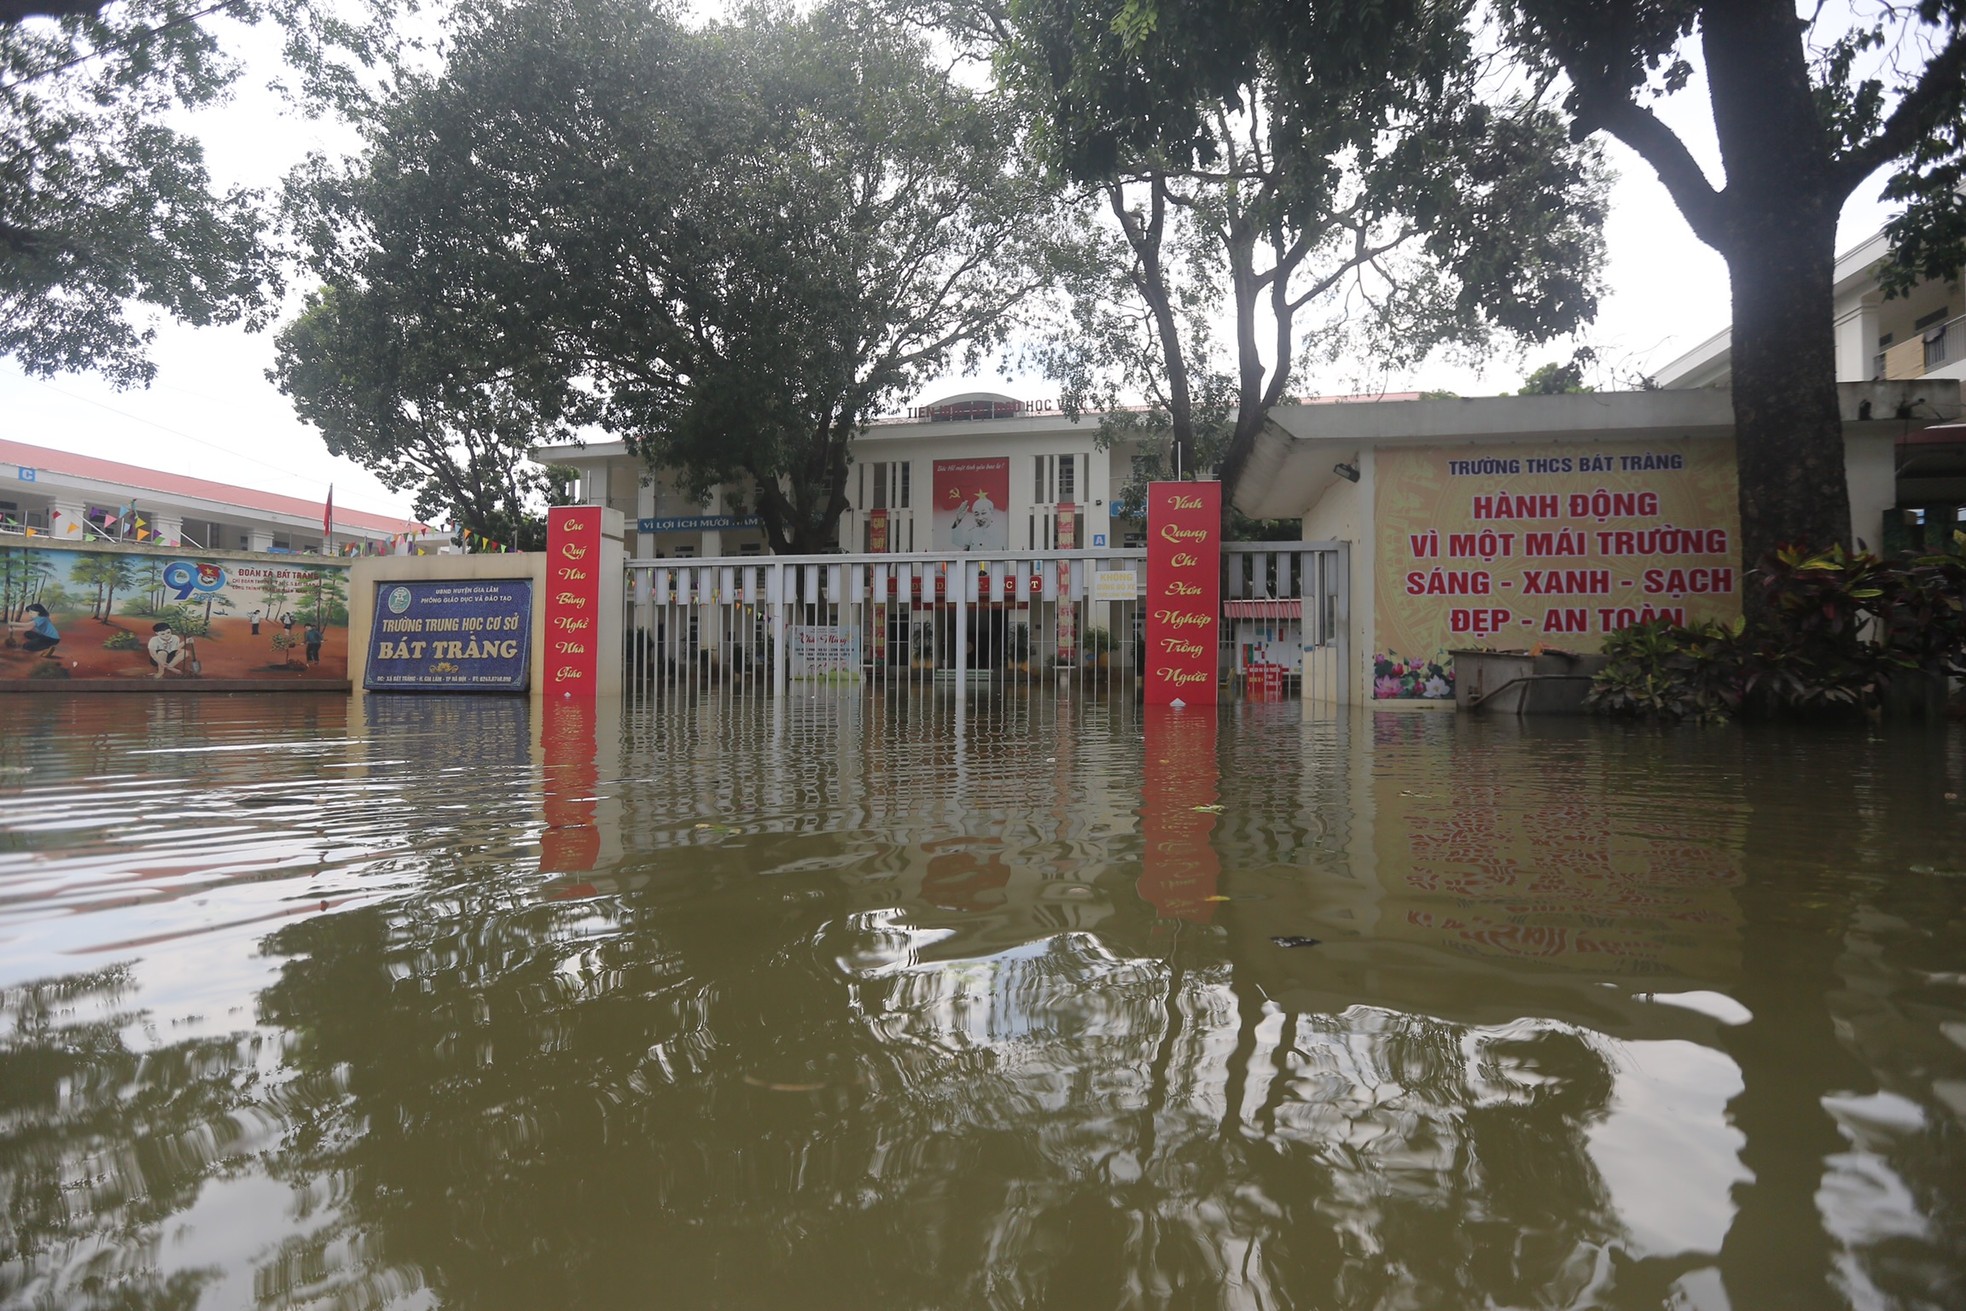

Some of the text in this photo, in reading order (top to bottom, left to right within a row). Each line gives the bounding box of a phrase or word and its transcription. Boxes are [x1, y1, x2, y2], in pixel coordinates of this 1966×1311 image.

[1026, 399, 1052, 414] HỌC
[1449, 453, 1683, 475] TRƯỜNG THCS BÁT TRÀNG
[22, 469, 33, 480] C
[1167, 495, 1203, 510] Vinh
[1473, 489, 1658, 522] HÀNH ĐỘNG
[563, 518, 585, 532] Cao
[644, 520, 653, 529] VÌ
[656, 520, 674, 530] LỢI
[677, 518, 698, 528] ÍCH
[700, 517, 729, 527] MƯỜI
[1095, 535, 1104, 545] A
[1161, 523, 1208, 544] Quang
[1410, 524, 1727, 562] VÌ MỘT MÁI TRƯỜNG
[562, 543, 587, 560] Quý
[238, 567, 261, 577] ĐOÀN
[276, 569, 291, 579] BÁT
[292, 570, 320, 580] TRÀNG
[558, 567, 587, 580] Nào
[453, 586, 472, 595] HUYỆN
[486, 585, 499, 593] LÂM
[1165, 581, 1202, 596] Hơn
[1406, 567, 1490, 595] SÁNG
[1522, 570, 1609, 594] XANH
[1643, 568, 1732, 598] SẠCH
[421, 594, 513, 604] PHÒNG GIÁO DỤC VÀ ĐÀO TẠO
[383, 612, 519, 634] TRƯỜNG TRUNG HỌC CƠ SỞ
[554, 616, 590, 633] Nghề
[1154, 609, 1212, 629] Nghiệp
[1450, 608, 1511, 637] ĐẸP
[1543, 609, 1588, 632] AN
[378, 635, 518, 660] BÁT TRÀNG
[555, 641, 585, 654] Nhà
[1160, 638, 1204, 658] Trồng
[555, 666, 582, 682] Giáo
[1157, 667, 1208, 687] Người
